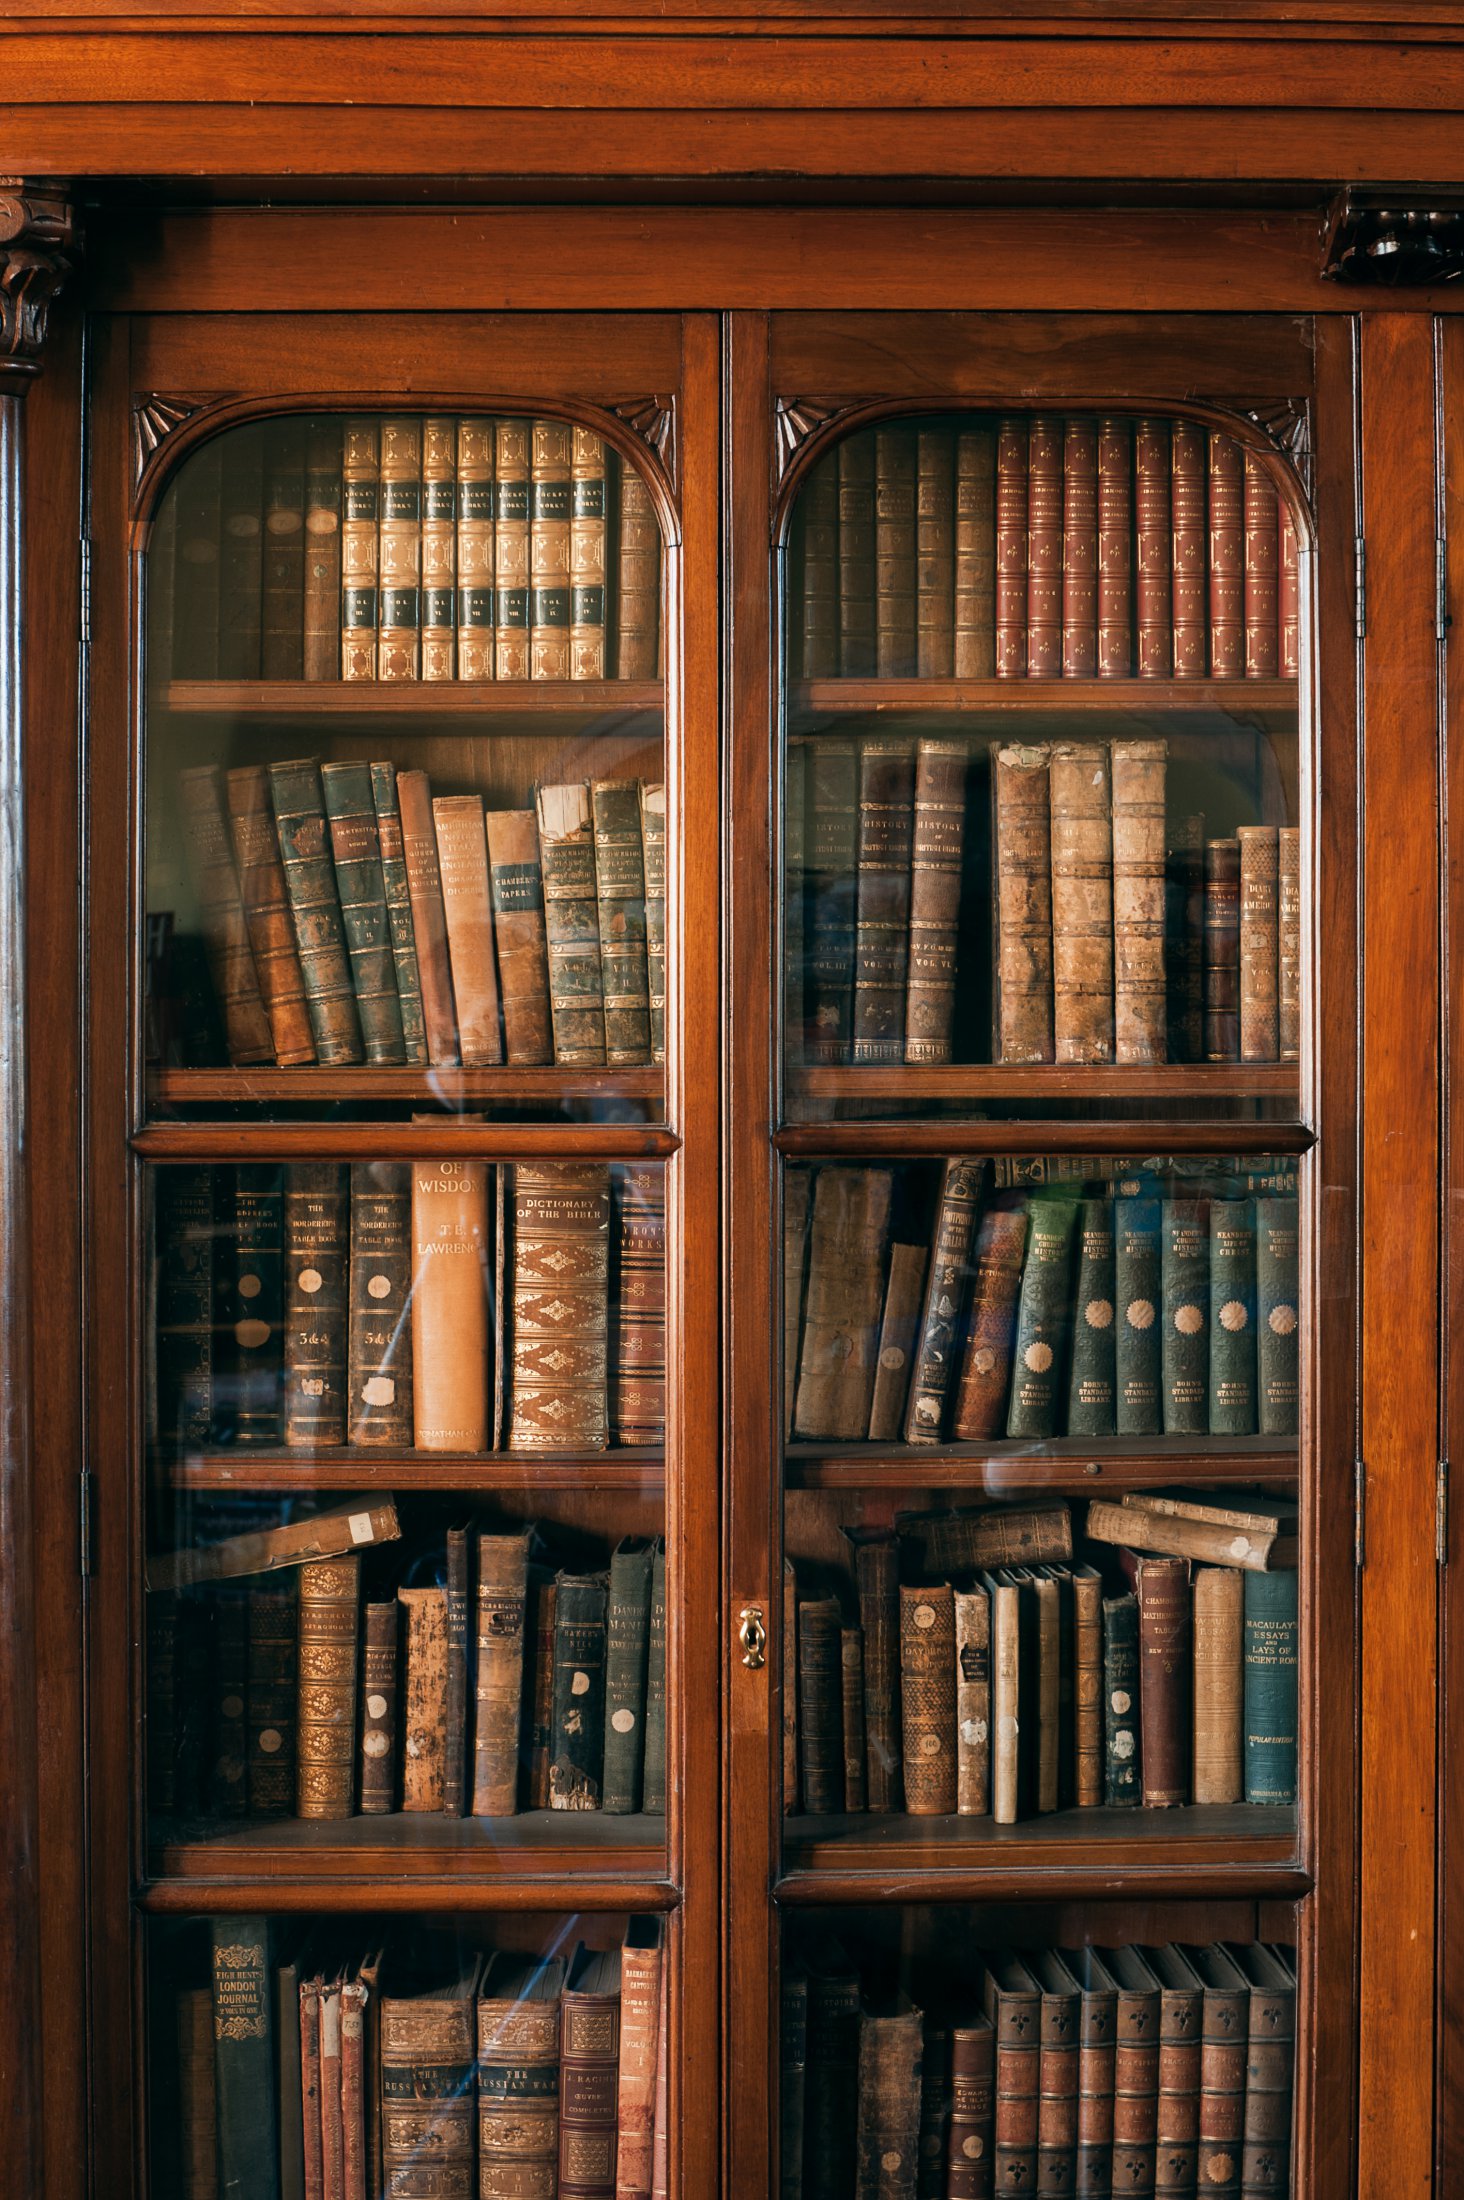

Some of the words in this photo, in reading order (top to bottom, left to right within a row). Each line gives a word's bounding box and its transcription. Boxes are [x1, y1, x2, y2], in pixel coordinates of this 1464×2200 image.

[863, 820, 908, 830] HISTORY
[918, 820, 961, 832] HISTORY
[916, 958, 937, 968] VOL.
[440, 1162, 462, 1175] OF
[418, 1180, 481, 1193] WISDOM
[307, 1204, 324, 1213] THE
[526, 1199, 595, 1209] DICTIONARY
[373, 1205, 389, 1215] THE
[517, 1209, 532, 1218] OF
[538, 1209, 560, 1219] THE
[567, 1210, 601, 1219] BIBLE
[292, 1235, 316, 1244] TABLE
[417, 1242, 475, 1254] LAWRENC
[1219, 1248, 1250, 1257] CHRIST
[1254, 1631, 1290, 1640] ESSAYS
[1252, 1645, 1276, 1655] LAYS
[1278, 1647, 1292, 1655] OF
[1248, 1735, 1271, 1744] POPULAR
[1271, 1736, 1294, 1744] EDITION
[216, 1971, 236, 1979] EIGH
[219, 1981, 256, 1992] LONDON
[217, 1994, 259, 2004] JOURNAL
[418, 2070, 439, 2079] THE
[506, 2070, 529, 2079] THE
[956, 2088, 988, 2097] EDWARD
